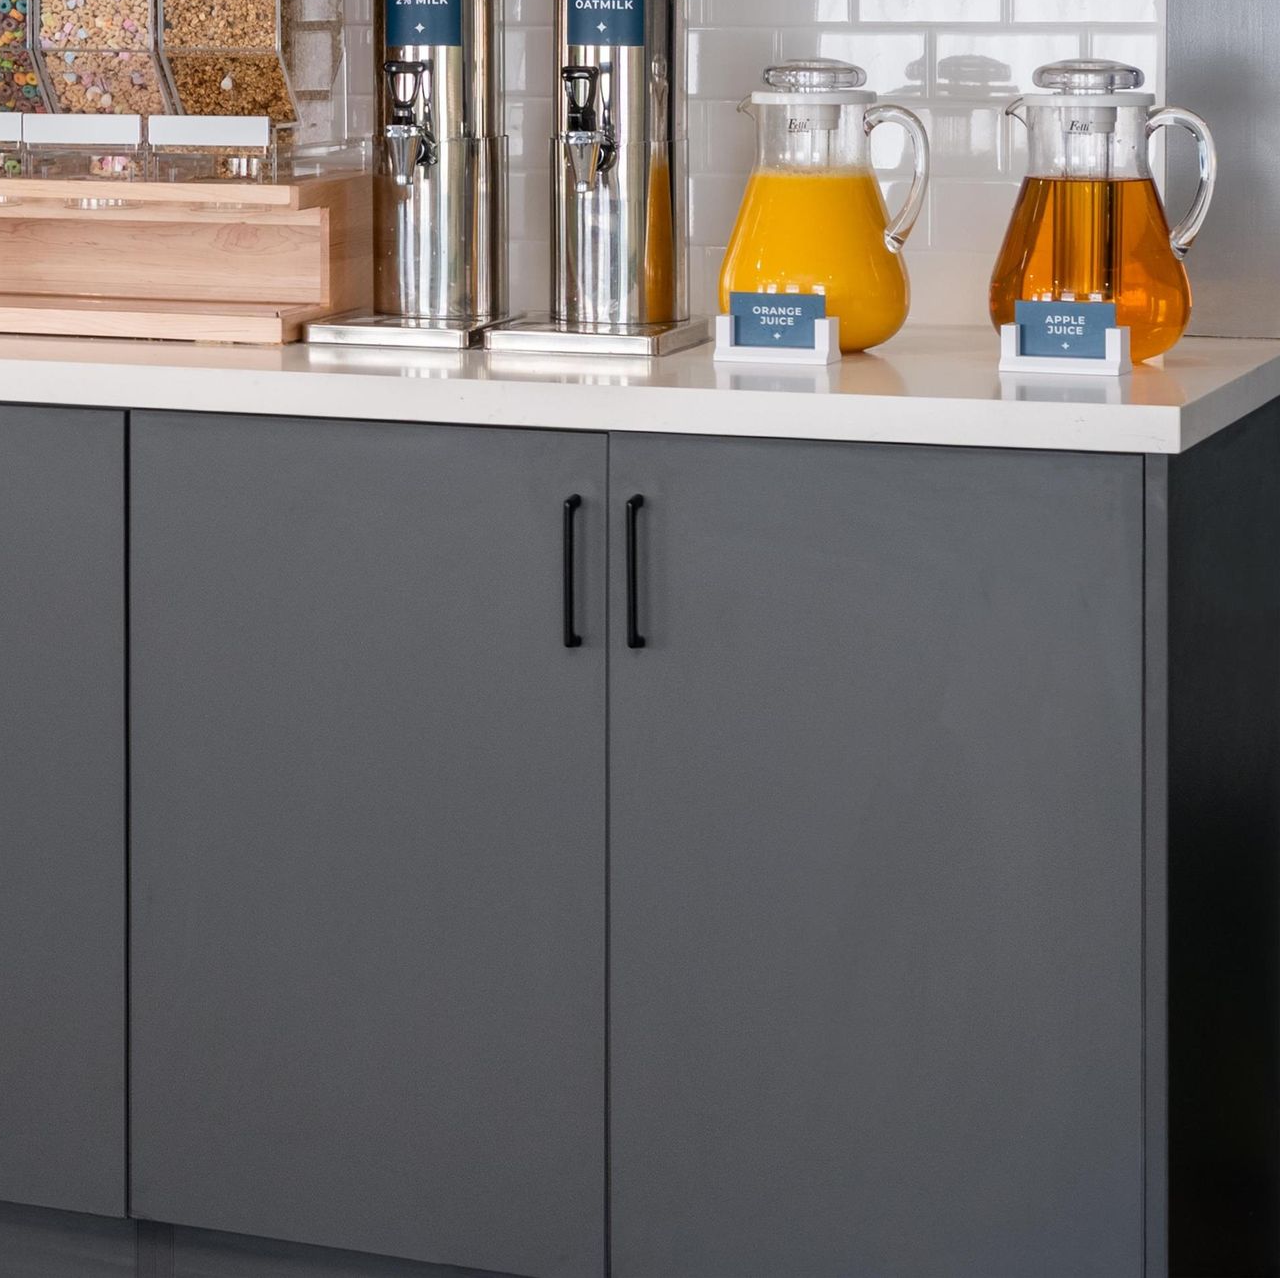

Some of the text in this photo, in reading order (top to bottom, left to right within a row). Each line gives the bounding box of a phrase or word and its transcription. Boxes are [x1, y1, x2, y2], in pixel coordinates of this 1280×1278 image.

[575, 0, 634, 10] OATMILK
[752, 306, 802, 316] ORANGE
[760, 316, 795, 326] JUICE
[1045, 315, 1086, 325] APPLE
[1047, 325, 1084, 335] JUICE
